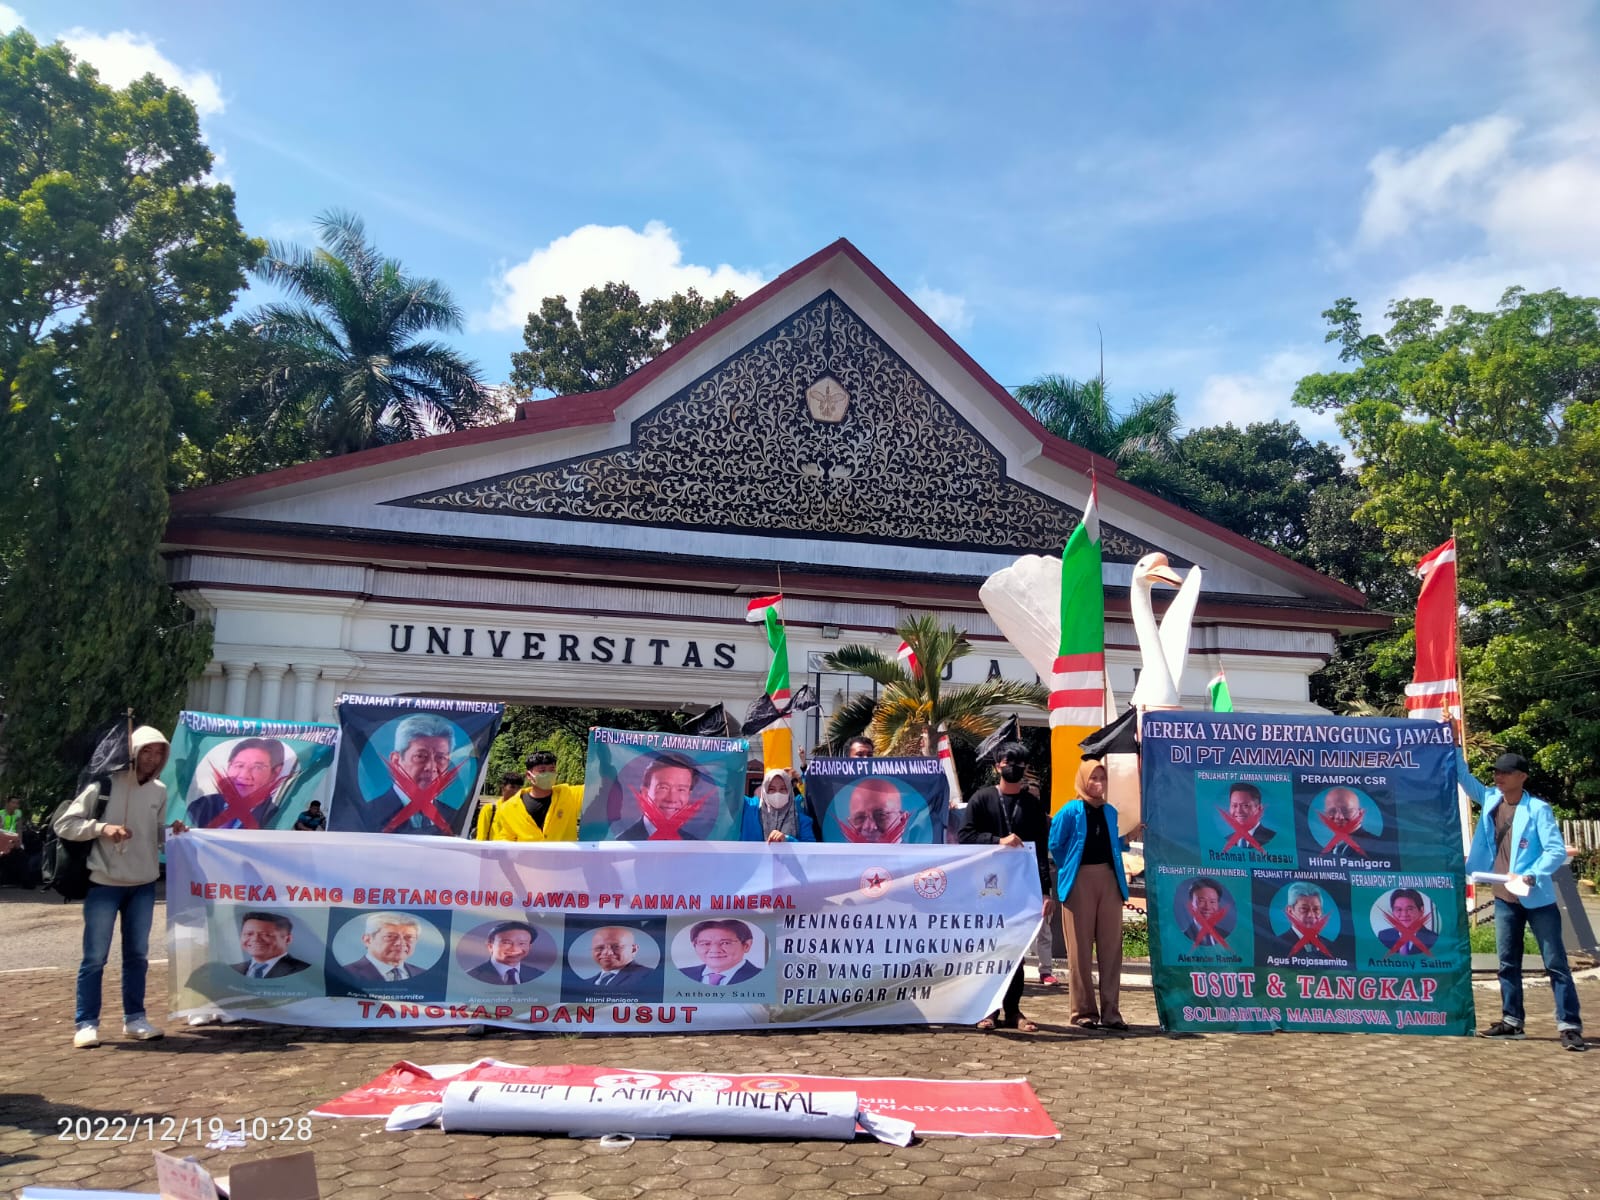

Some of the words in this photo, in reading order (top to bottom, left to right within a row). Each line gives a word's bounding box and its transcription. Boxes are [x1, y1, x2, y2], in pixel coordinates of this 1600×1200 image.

[390, 624, 736, 669] UNIVERSITAS
[342, 694, 394, 707] PENJAHAT
[398, 698, 411, 708] PT
[414, 699, 453, 711] AMMAN
[456, 701, 499, 714] MINERAL
[180, 710, 240, 735] PERAMPOK
[243, 721, 256, 735] PT
[260, 722, 302, 740] AMMAN
[594, 730, 644, 746] PENJAHAT
[646, 735, 658, 747] PT
[662, 736, 699, 750] AMMAN
[702, 739, 744, 752] MINERAL
[1143, 721, 1206, 740] MEREKA
[1210, 723, 1256, 741] YANG
[1261, 724, 1391, 745] BERTANGGUNG
[1395, 726, 1454, 750] JAWAB
[1171, 745, 1191, 764] DI
[1197, 747, 1226, 764] PT
[1229, 748, 1314, 768] AMMAN
[1320, 750, 1420, 768] MINERAL
[857, 762, 868, 775] PT
[872, 760, 906, 775] AMMAN
[1198, 772, 1228, 780] PENJAHAT
[1230, 772, 1238, 780] PT
[1240, 773, 1262, 782] AMMAN
[1264, 774, 1290, 782] MINERAL
[1301, 774, 1362, 785] PERAMPOK
[1364, 776, 1386, 785] CSR
[1188, 867, 1195, 875] PT
[1196, 868, 1220, 876] AMMAN
[1222, 869, 1248, 877] MINERAL
[1308, 857, 1336, 866] Hilmi
[1340, 858, 1391, 870] Panigoro
[1253, 870, 1284, 878] PENJAHAT
[1284, 870, 1292, 879] PT
[1294, 871, 1318, 880] AMMAN
[1320, 872, 1348, 880] MINERAL
[1352, 874, 1388, 888] PERAMPOK
[1388, 875, 1396, 888] PT
[1398, 876, 1424, 888] AMMAN
[1426, 876, 1454, 888] MINERAL
[190, 882, 276, 901] MEREKA
[286, 886, 343, 903] YANG
[353, 888, 514, 908] BERTANGGUNG
[522, 892, 590, 909] JAWAB
[599, 894, 624, 908] PT
[630, 894, 701, 910] AMMAN
[710, 894, 796, 910] MINERAL
[784, 914, 918, 930] MENINGGALNYA
[928, 914, 1005, 929] PEKERJA
[784, 938, 875, 954] RUSAKNYA
[884, 937, 998, 954] LINGKUNGAN
[1267, 956, 1290, 966] Agus
[1292, 956, 1348, 967] Projosasmito
[1368, 958, 1416, 970] Anthony
[1420, 959, 1452, 968] Salim
[784, 963, 818, 980] CSR
[828, 963, 872, 980] YANG
[882, 962, 934, 979] TIDAK
[675, 991, 726, 1000] Anthony
[732, 991, 767, 999] Salim
[784, 987, 887, 1004] PELANGGAR
[896, 986, 932, 1001] HAM
[1190, 972, 1256, 998] USUT
[1266, 972, 1286, 998] &
[1296, 974, 1438, 1002] TANGKAP
[358, 1001, 513, 1021] TANGKAP
[530, 1006, 595, 1024] DAN
[612, 1006, 698, 1024] USUT
[1183, 1006, 1282, 1022] SOLIDARITAS
[1286, 1008, 1392, 1024] MAHASISWA
[1396, 1010, 1447, 1029] JAMBI
[880, 1104, 1032, 1112] MASYARAKAT
